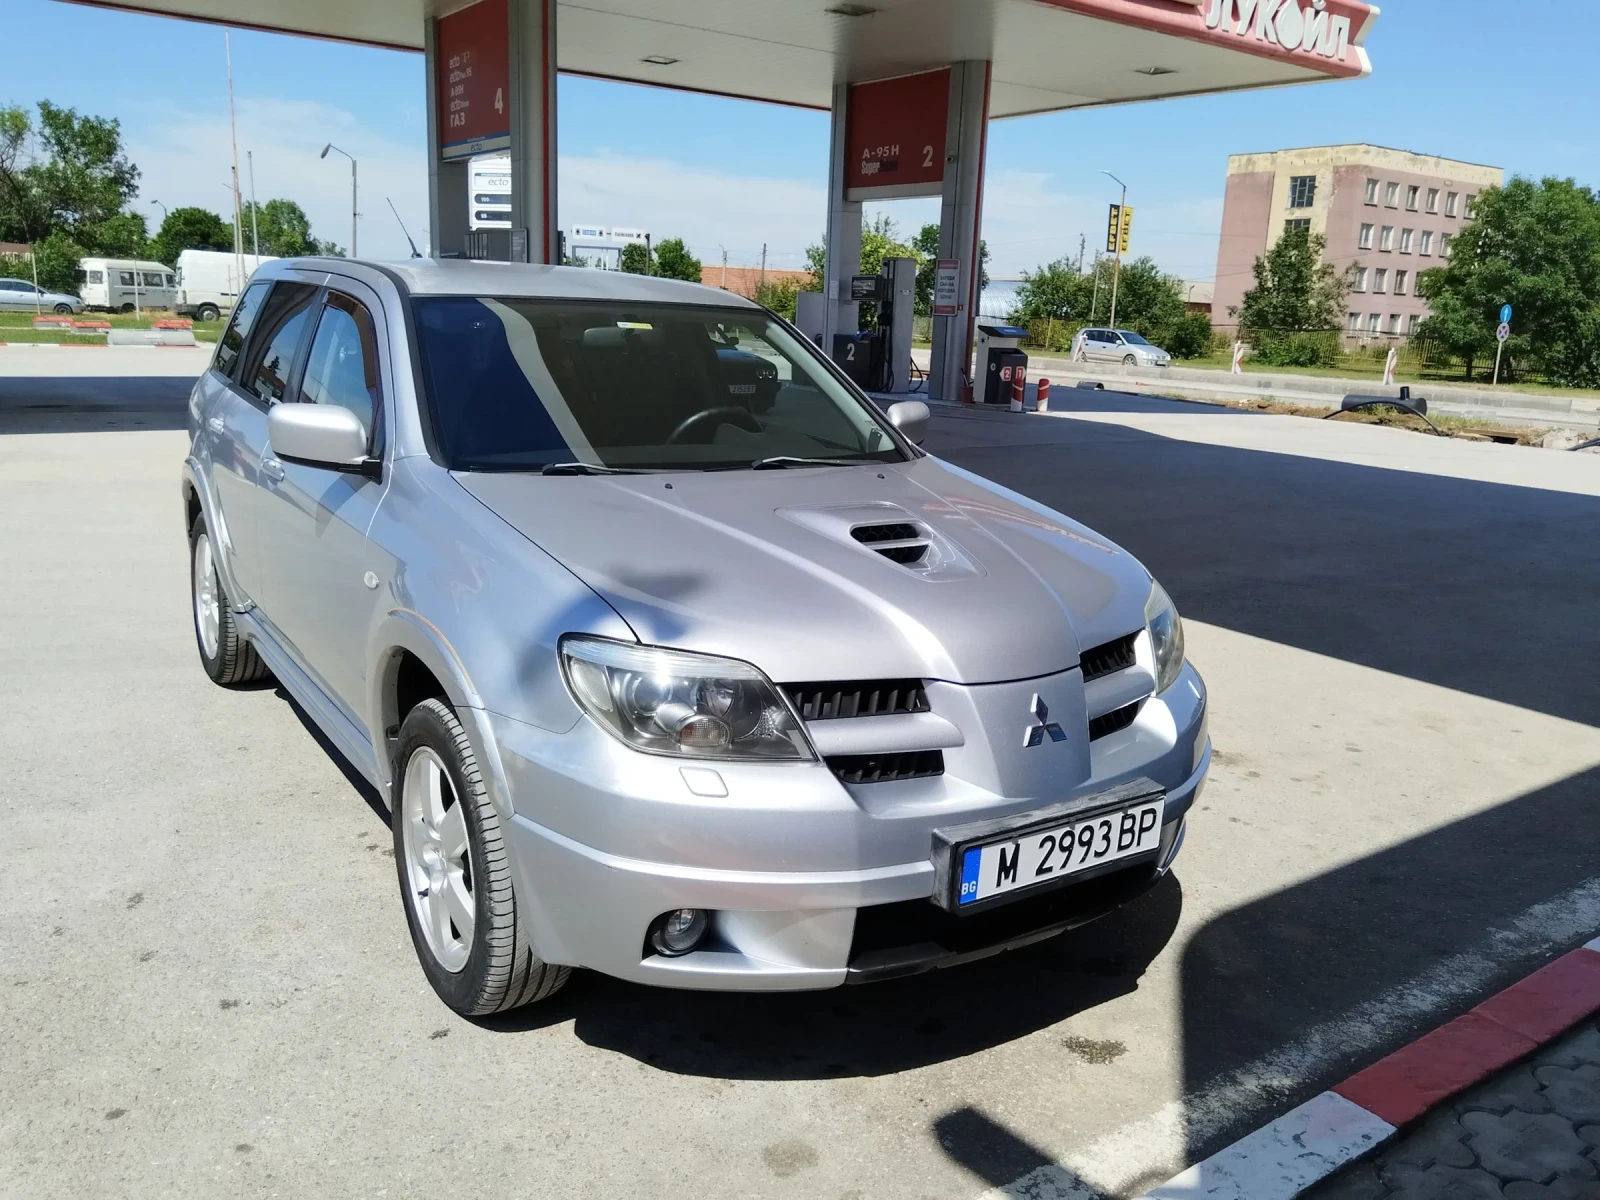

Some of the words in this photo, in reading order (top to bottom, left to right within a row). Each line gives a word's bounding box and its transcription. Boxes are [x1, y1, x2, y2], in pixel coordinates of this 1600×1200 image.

[1205, 0, 1350, 62] ЛУКОЙЛ
[494, 88, 503, 114] 4
[450, 112, 465, 127] ГАЗ
[922, 145, 934, 167] 2
[488, 177, 509, 186] ecto
[846, 342, 855, 361] 2
[1004, 369, 1010, 379] 2
[1017, 369, 1022, 379] 1
[996, 844, 1020, 888] M
[961, 880, 977, 896] BG
